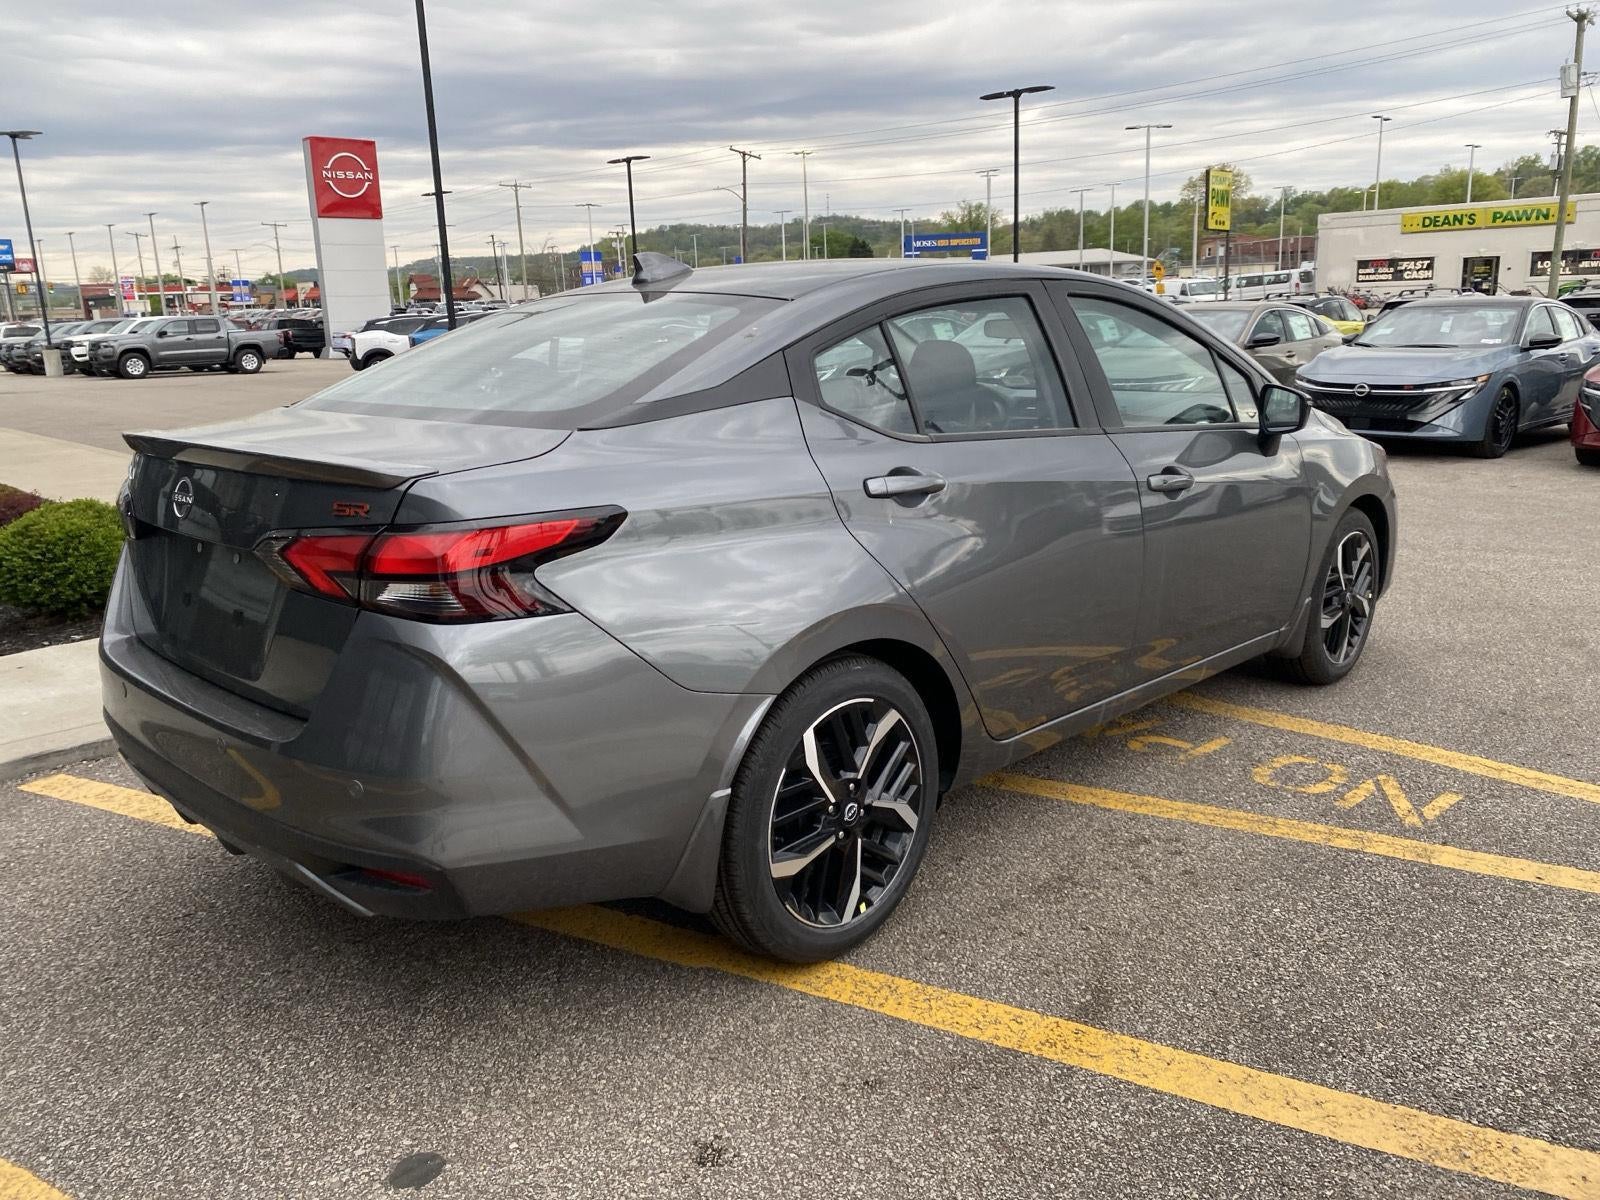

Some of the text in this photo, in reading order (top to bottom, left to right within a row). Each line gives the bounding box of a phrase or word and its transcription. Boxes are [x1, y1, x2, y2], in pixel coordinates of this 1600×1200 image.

[322, 170, 373, 180] NISSAN
[1211, 188, 1231, 208] PAWN
[1422, 208, 1550, 228] DEAN'S PAWN
[912, 240, 938, 248] MOSES
[1402, 260, 1431, 271] FAST
[1537, 260, 1566, 268] LON
[1403, 269, 1432, 280] CASH
[1547, 267, 1573, 275] SLL
[1358, 274, 1393, 282] DIAMONDS
[332, 502, 370, 517] SR
[1250, 755, 1463, 828] NO
